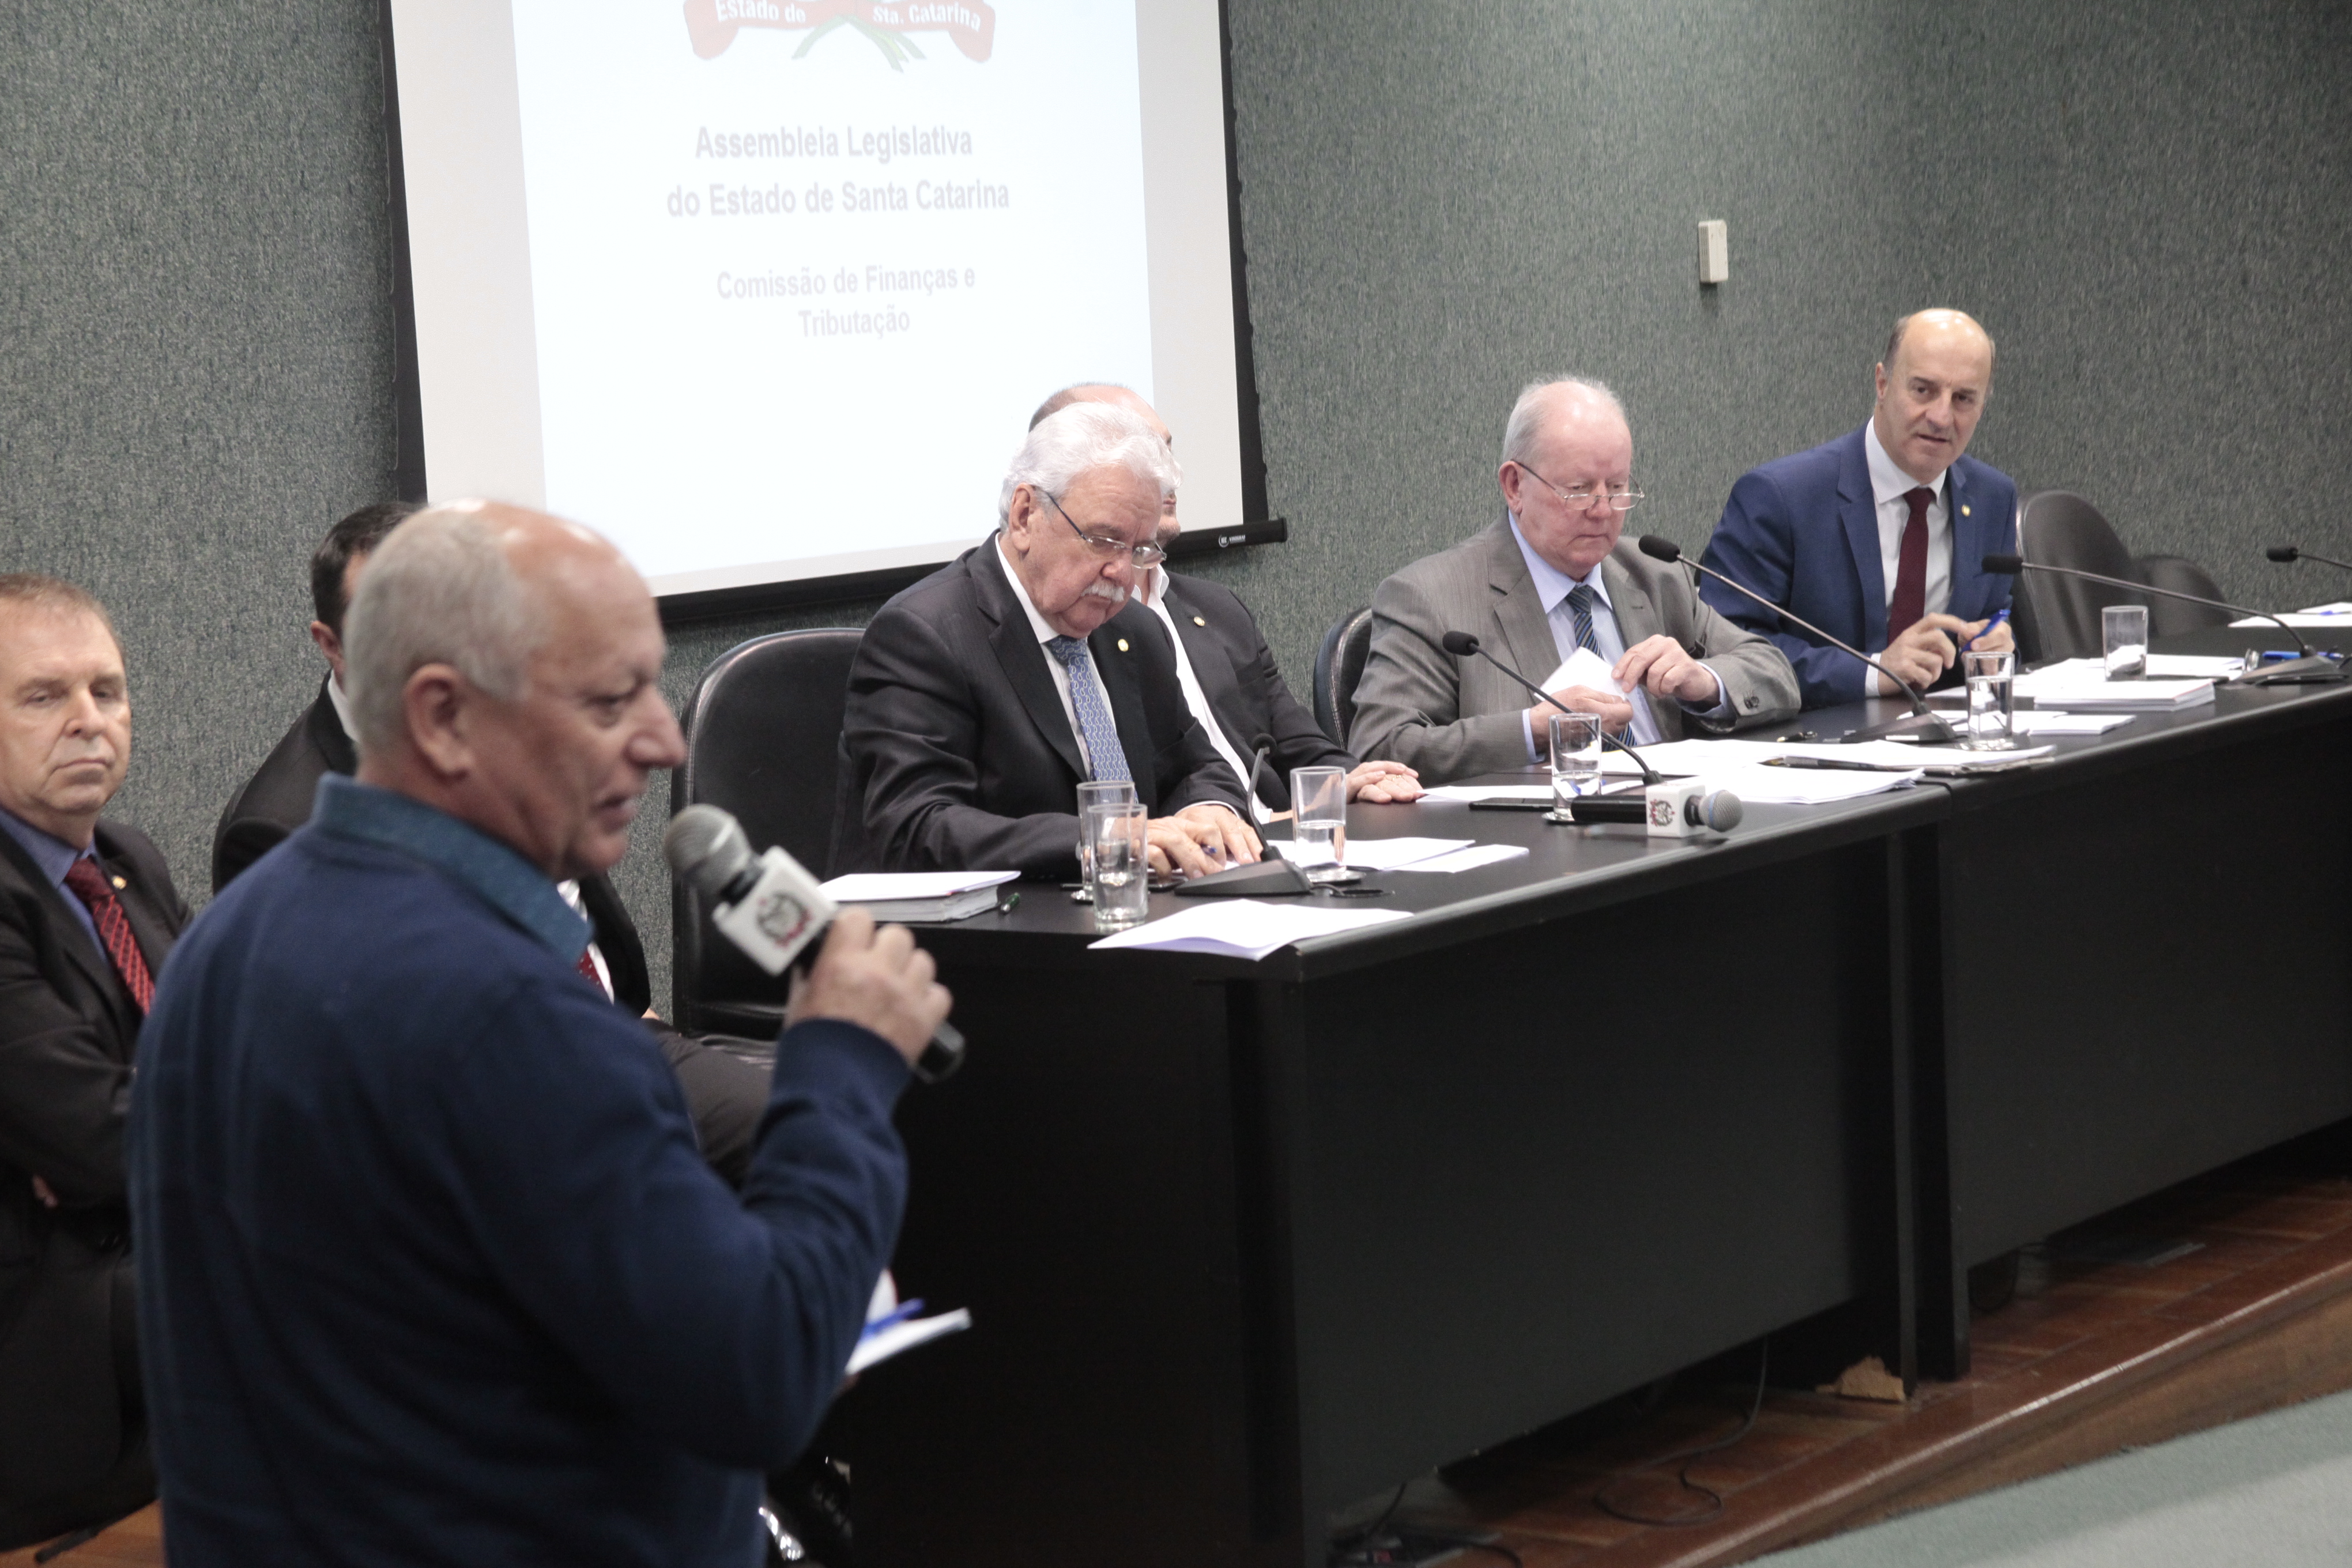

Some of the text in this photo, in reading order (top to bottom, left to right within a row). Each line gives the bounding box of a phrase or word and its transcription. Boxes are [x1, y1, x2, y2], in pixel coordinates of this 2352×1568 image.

[715, 0, 981, 32] Estado de Sta. Catarina
[696, 125, 972, 164] Assembleia Legislativa
[667, 179, 1009, 217] do Estado de Santa Catarina
[717, 265, 975, 299] Comissão de Finanças e
[798, 304, 910, 338] Tributação
